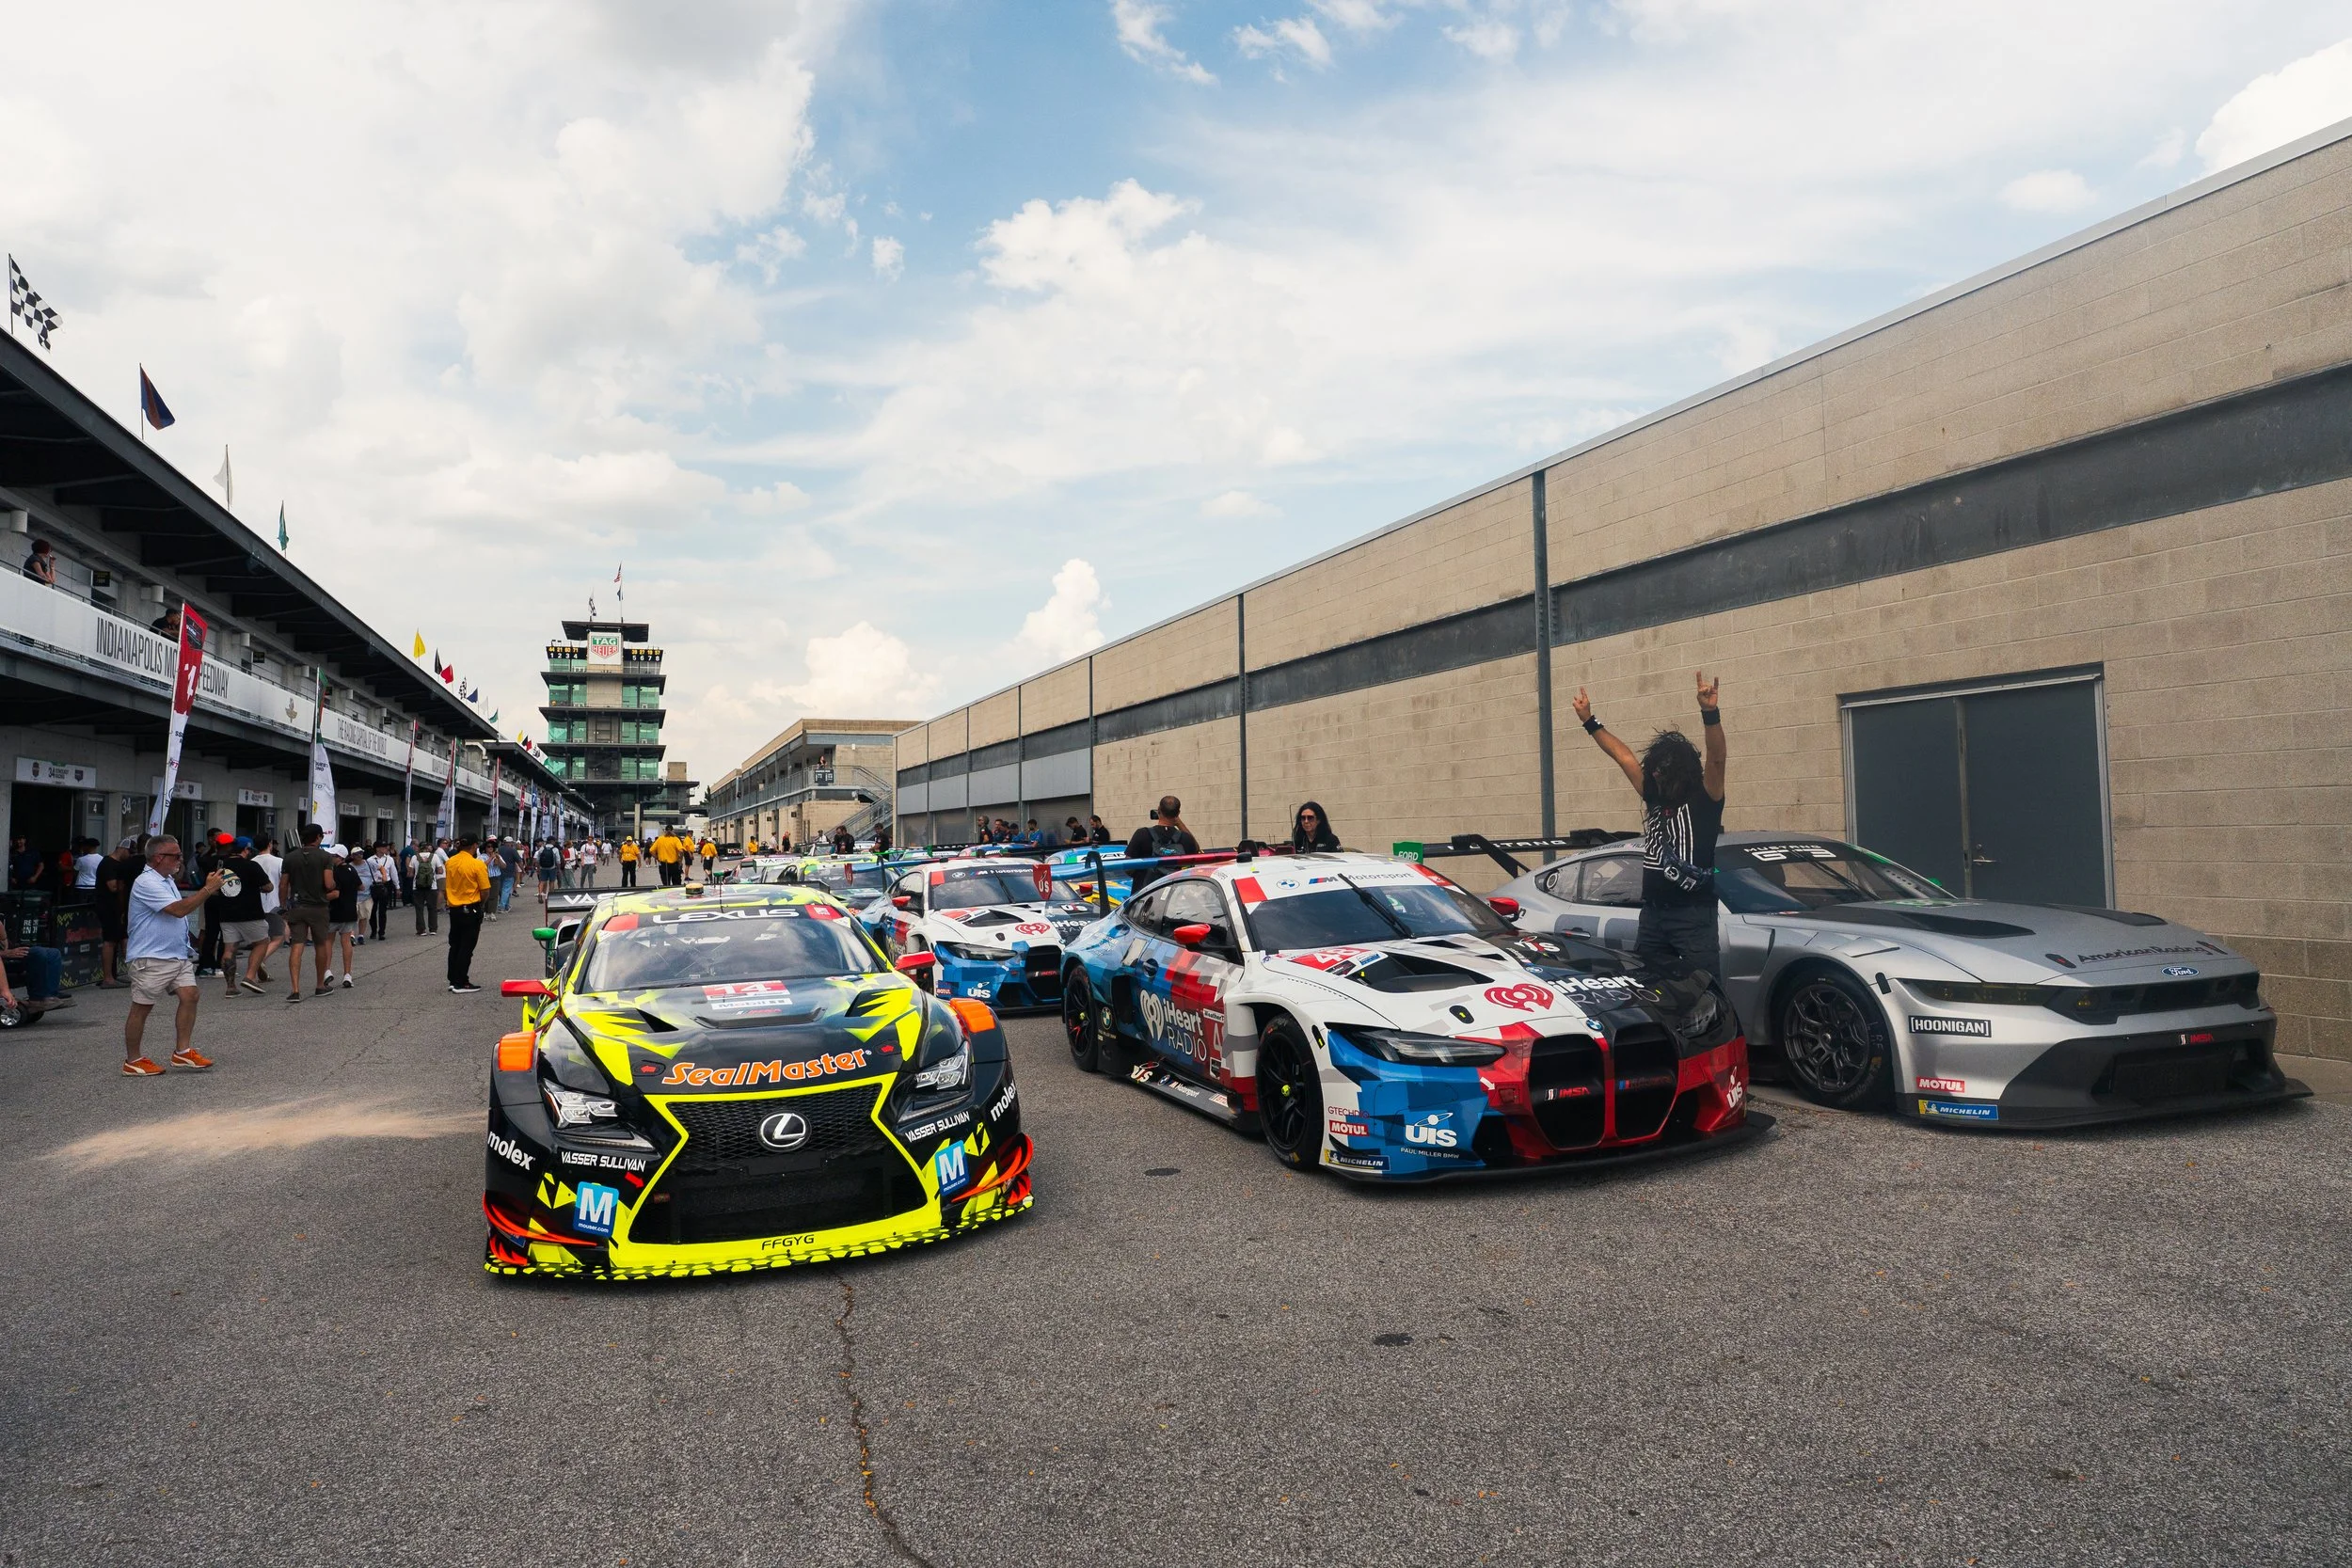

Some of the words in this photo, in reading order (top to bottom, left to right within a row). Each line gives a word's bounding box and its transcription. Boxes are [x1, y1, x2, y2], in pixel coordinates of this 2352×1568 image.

[96, 616, 163, 674] INDIANAPOLIS
[592, 646, 618, 657] HEUER
[121, 797, 132, 815] 34
[1398, 850, 1419, 862] FORD
[653, 909, 800, 924] LEXUS
[2168, 967, 2194, 976] Ford
[714, 983, 771, 995] 14
[967, 988, 991, 998] UIS
[1548, 975, 1645, 994] iHeart
[1566, 988, 1661, 1007] RADIO
[1163, 998, 1203, 1037] iHeart
[1167, 1025, 1207, 1062] RADIO
[661, 1049, 867, 1085] SealMaster
[1559, 1086, 1590, 1098] IMSA
[1919, 1078, 1963, 1091] MOTUL
[1725, 1081, 1744, 1108] UIS
[1940, 1106, 1991, 1116] MICHELIN
[904, 1122, 939, 1143] VASSER
[936, 1111, 971, 1131] SULLIVAN
[1330, 1122, 1368, 1135] MOTUL
[1405, 1124, 1457, 1148] UIS
[487, 1131, 533, 1171] molex
[1400, 1147, 1417, 1155] PAUL
[1418, 1149, 1442, 1158] MILLER
[561, 1151, 598, 1166] VASSER
[598, 1155, 646, 1172] SULLIVAN
[938, 1146, 965, 1186] M
[1340, 1156, 1384, 1166] MICHELIN
[579, 1187, 613, 1226] M
[578, 1222, 610, 1233] mouser.com
[761, 1233, 815, 1251] FFGYG
